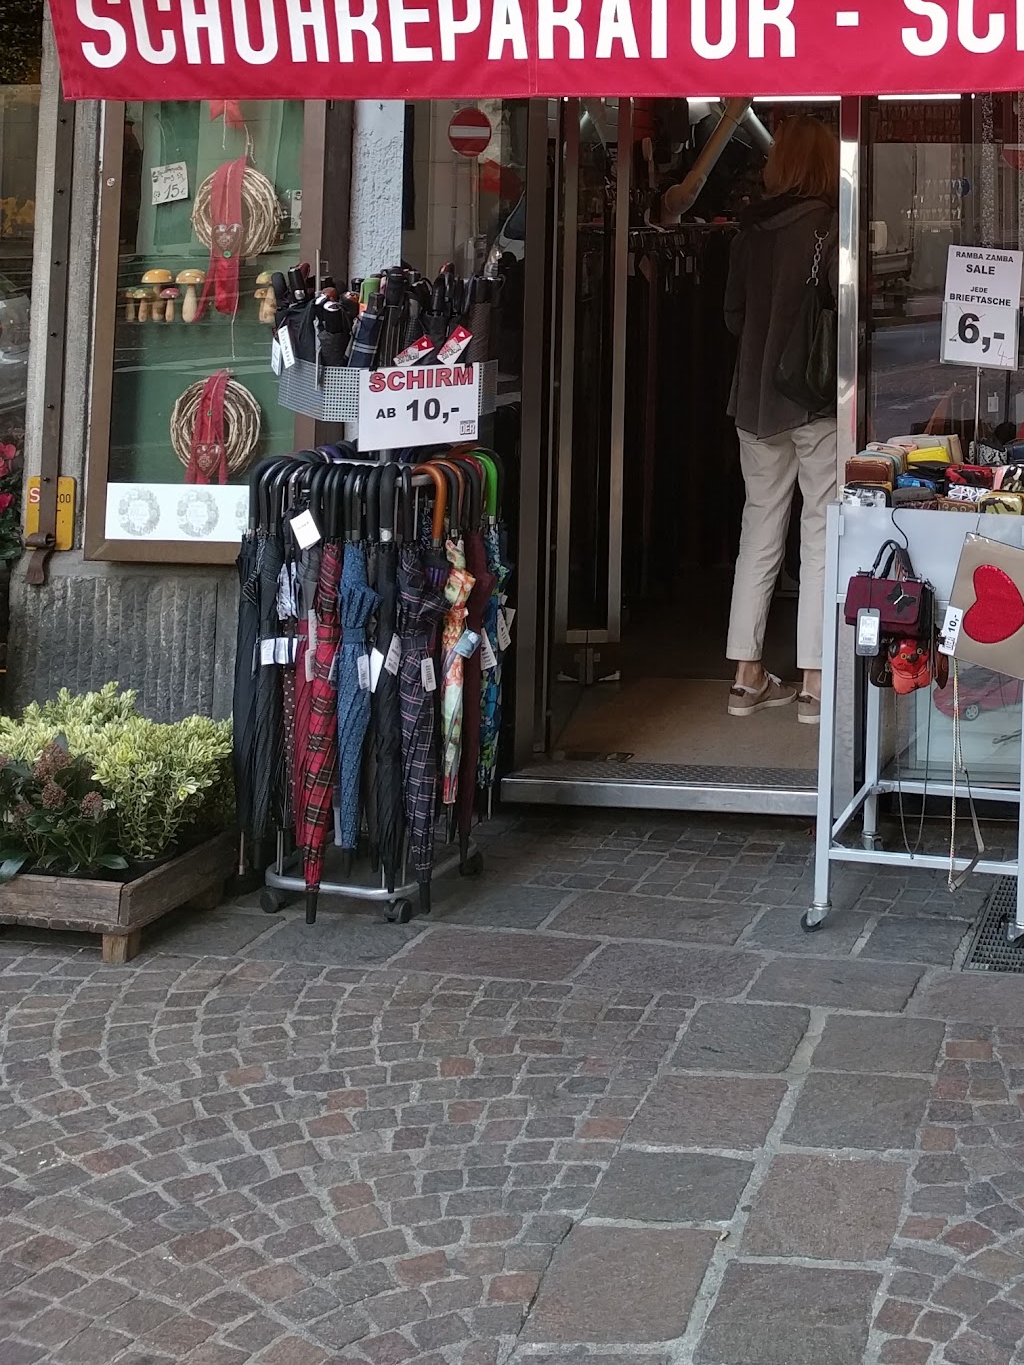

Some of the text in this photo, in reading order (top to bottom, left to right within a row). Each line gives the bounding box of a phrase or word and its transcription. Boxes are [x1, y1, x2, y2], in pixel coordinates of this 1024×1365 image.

[956, 251, 1014, 263] RAMBA ZAMBA
[966, 264, 996, 275] SALE
[970, 286, 988, 294] JEDE
[949, 293, 1011, 307] BRIEFTASCHE
[368, 365, 474, 393] SCHIRM
[376, 398, 459, 424] AB 10,-
[948, 614, 960, 632] 10,-
